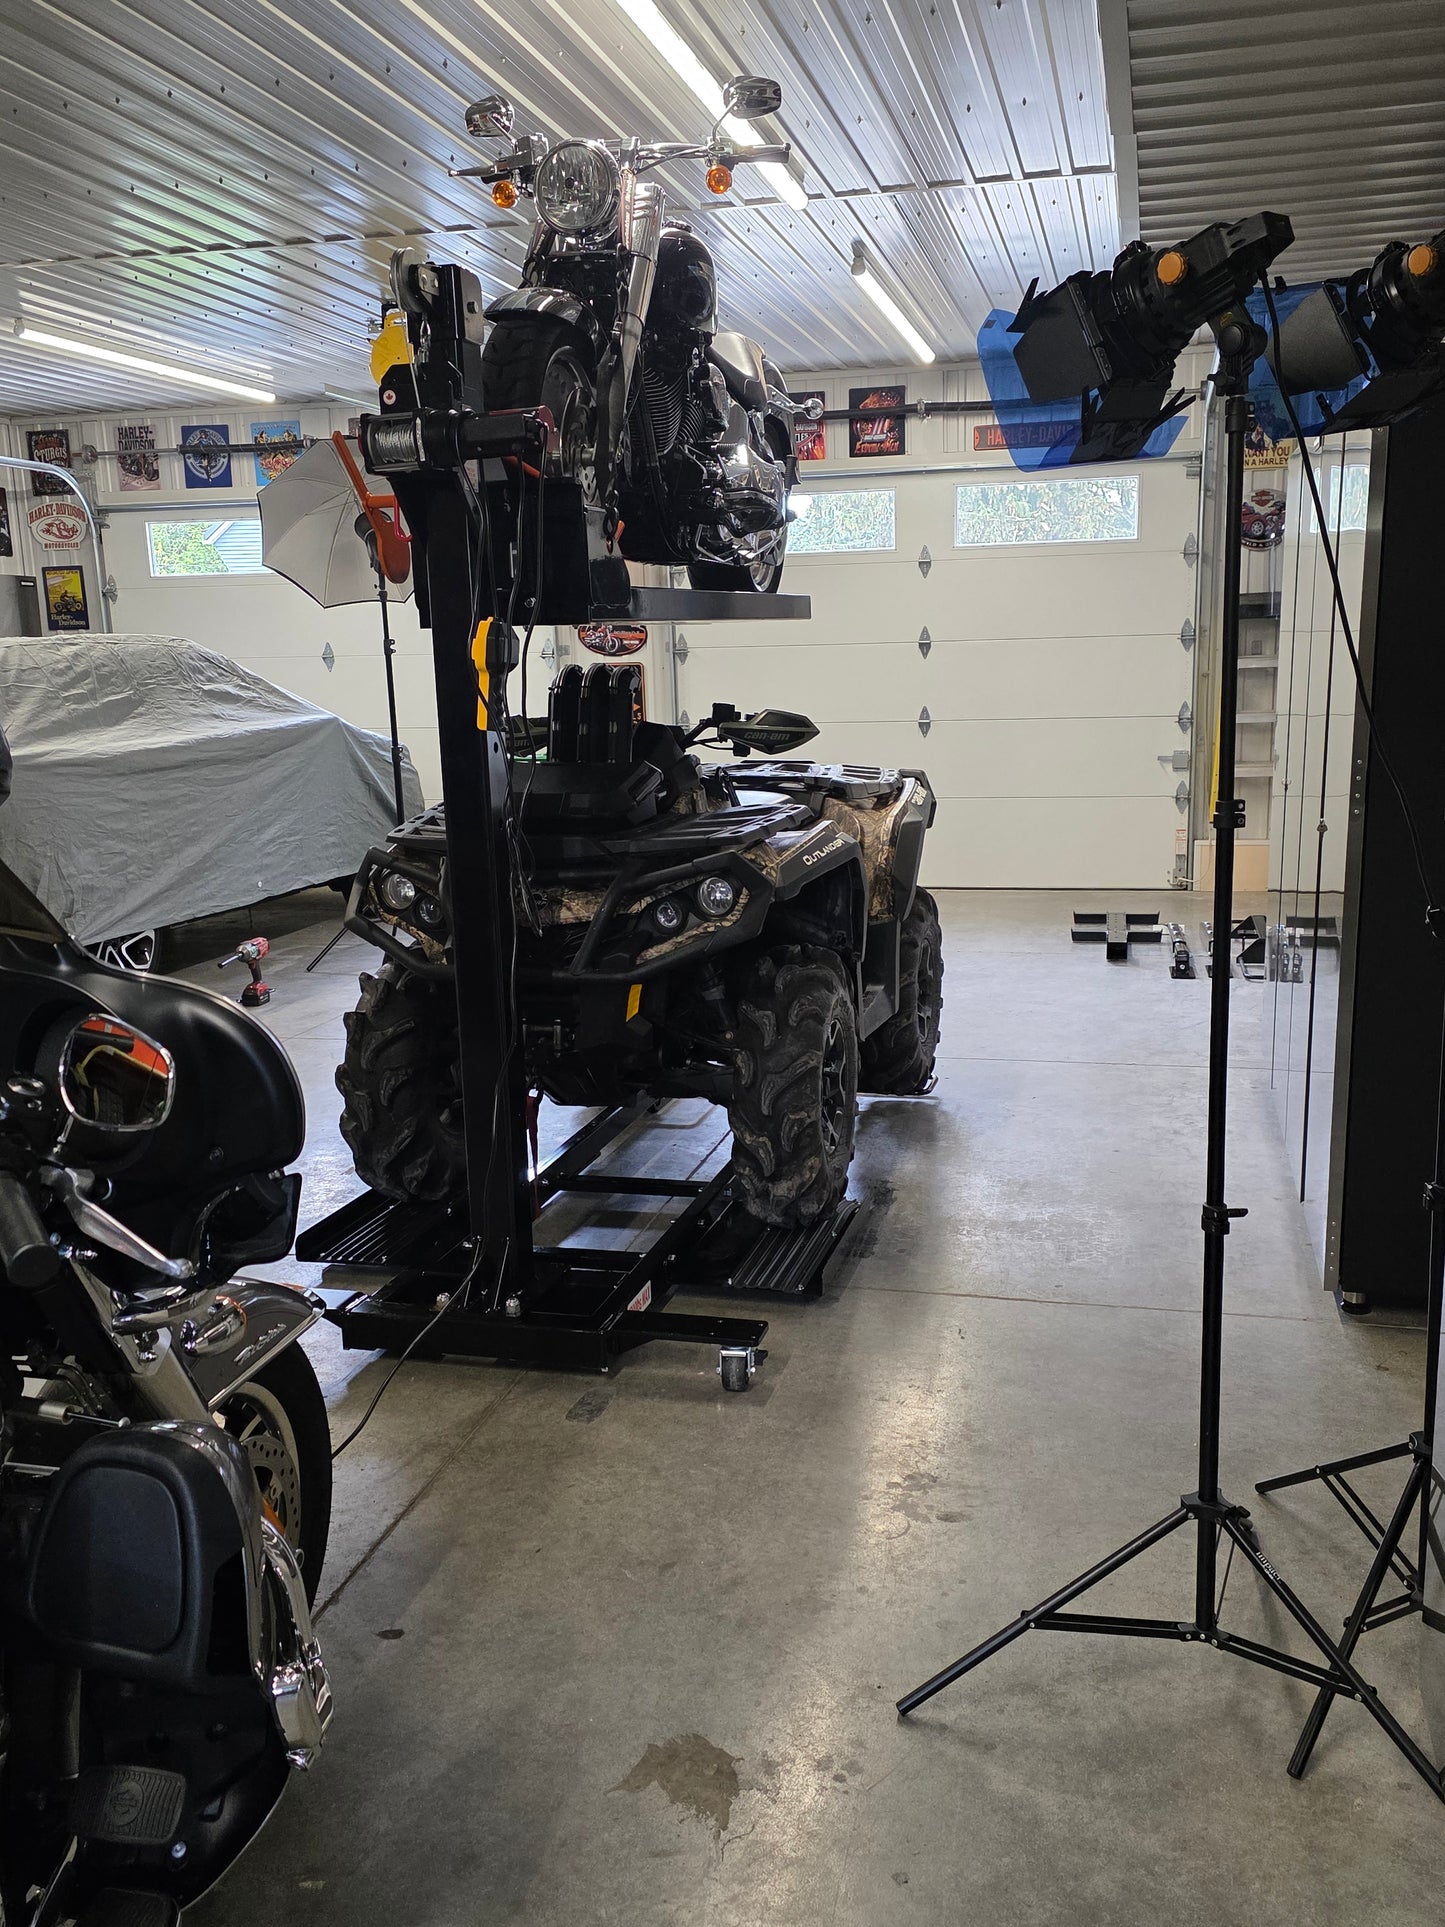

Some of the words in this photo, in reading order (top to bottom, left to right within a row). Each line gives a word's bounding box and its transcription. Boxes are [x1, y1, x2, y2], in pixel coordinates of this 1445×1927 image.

[117, 426, 153, 440] HARLEY-
[118, 438, 156, 451] DAVIDSON
[34, 447, 68, 463] STURGIS
[1271, 446, 1290, 457] YOU
[1258, 457, 1289, 466] HARLEY
[50, 613, 74, 621] Harley-
[744, 731, 791, 741] can-am
